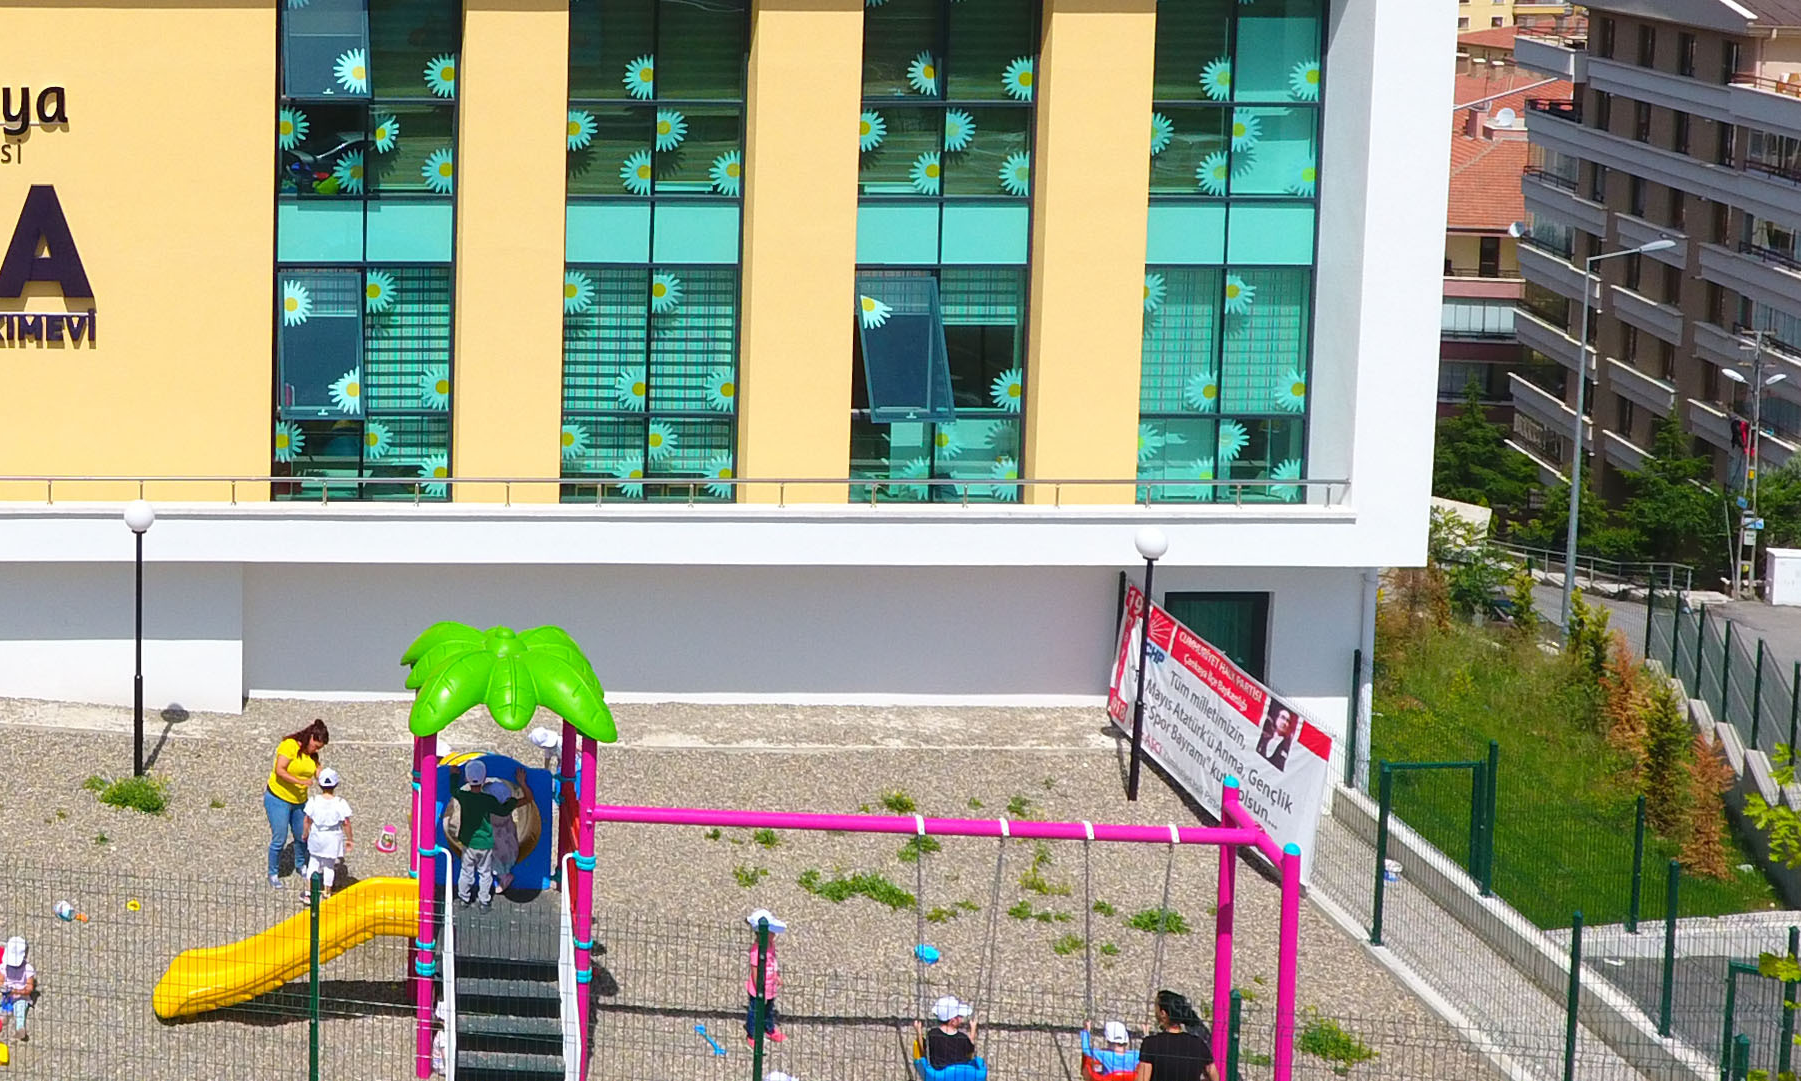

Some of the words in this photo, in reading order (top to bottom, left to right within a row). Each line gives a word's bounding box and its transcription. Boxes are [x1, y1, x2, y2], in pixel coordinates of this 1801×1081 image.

[1145, 642, 1165, 664] CHP
[1149, 706, 1171, 732] Spor
[1171, 670, 1190, 697] Tüm
[1190, 691, 1246, 750] milletimizin,
[1145, 679, 1172, 711] Mayıs
[1215, 740, 1245, 779] Anma,
[1248, 769, 1293, 814] Gençlik
